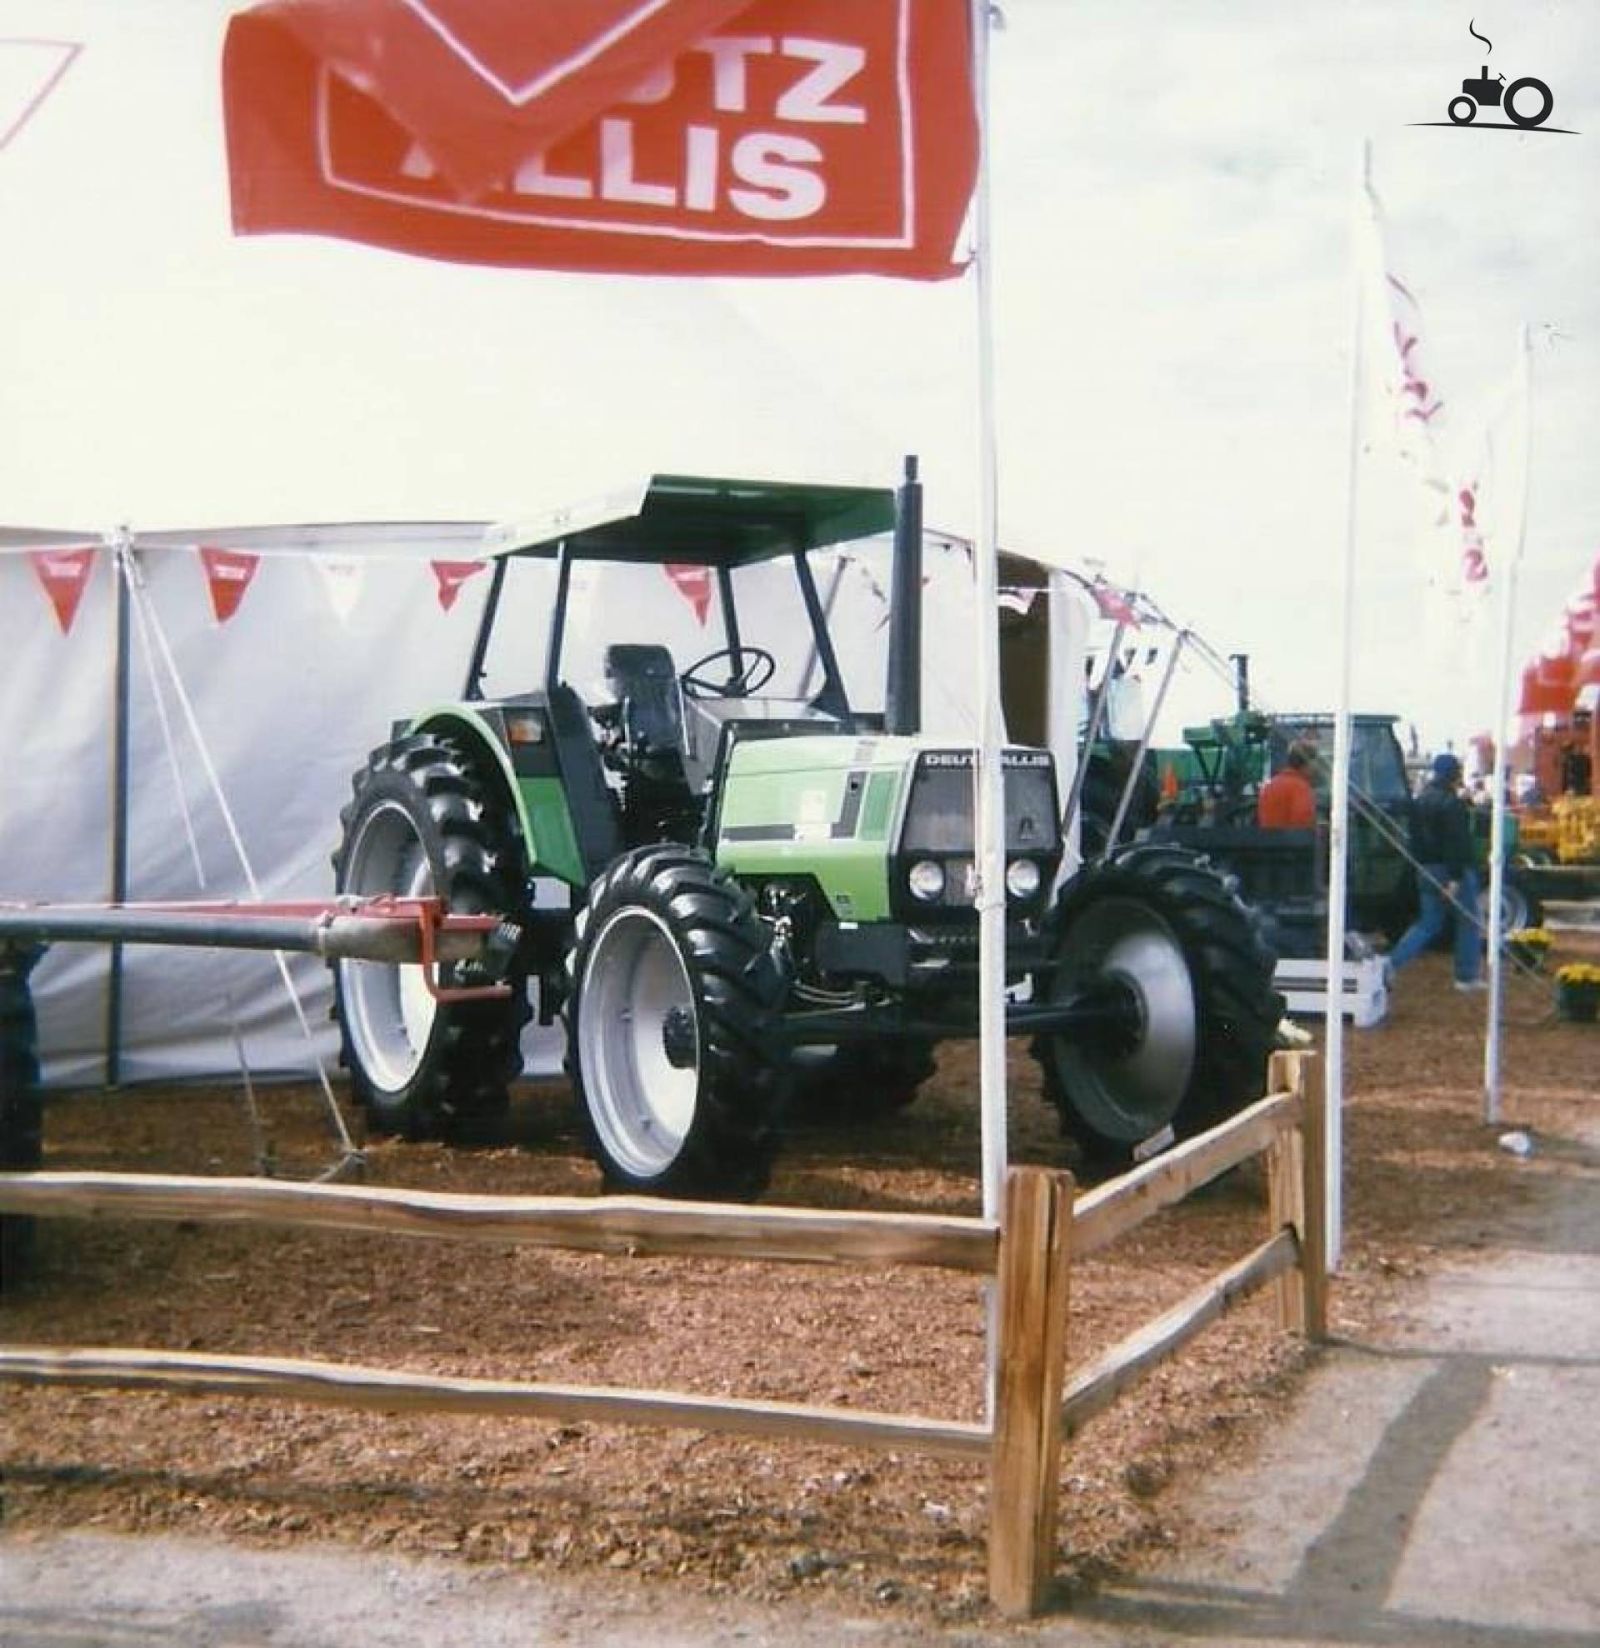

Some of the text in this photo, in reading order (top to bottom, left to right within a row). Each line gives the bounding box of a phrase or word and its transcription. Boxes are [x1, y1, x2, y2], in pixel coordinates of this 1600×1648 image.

[626, 36, 867, 124] TZ
[402, 118, 827, 220] LLIS
[925, 754, 977, 766] DEUT
